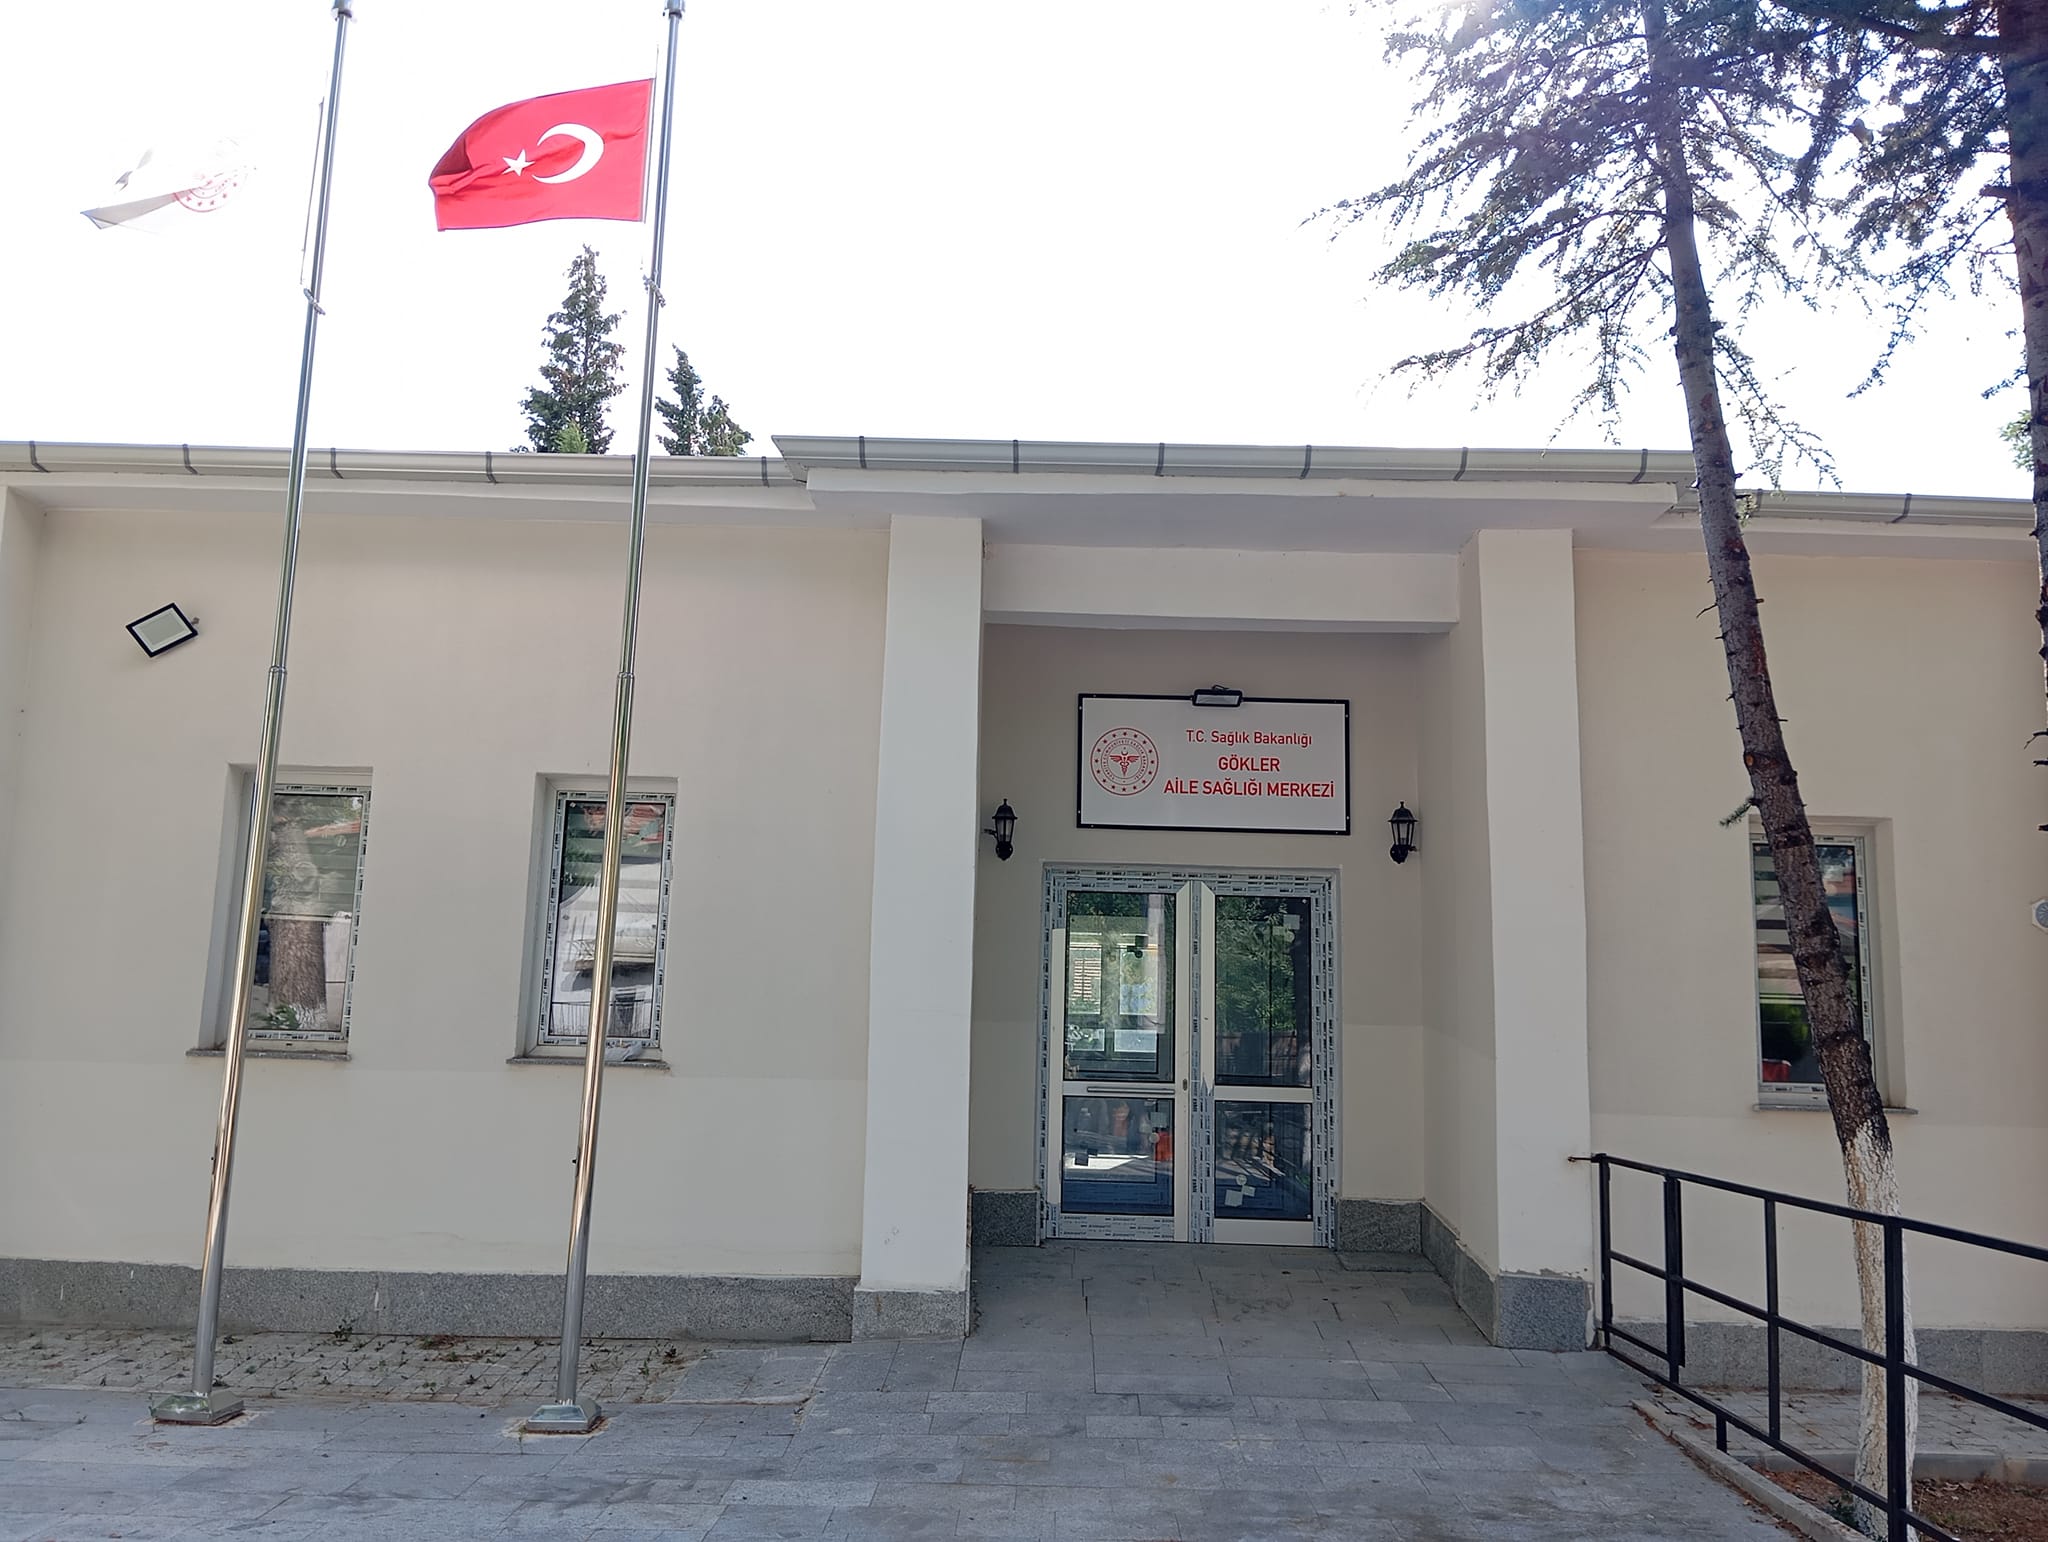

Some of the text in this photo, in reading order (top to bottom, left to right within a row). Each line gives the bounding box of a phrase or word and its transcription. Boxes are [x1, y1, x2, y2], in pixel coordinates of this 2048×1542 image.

[1187, 729, 1312, 748] T.C. Sağlık Bakanlığı
[1218, 754, 1280, 772] GÖKLER
[1164, 777, 1334, 797] AİLE SAĞLIĞI MERKEZİ
